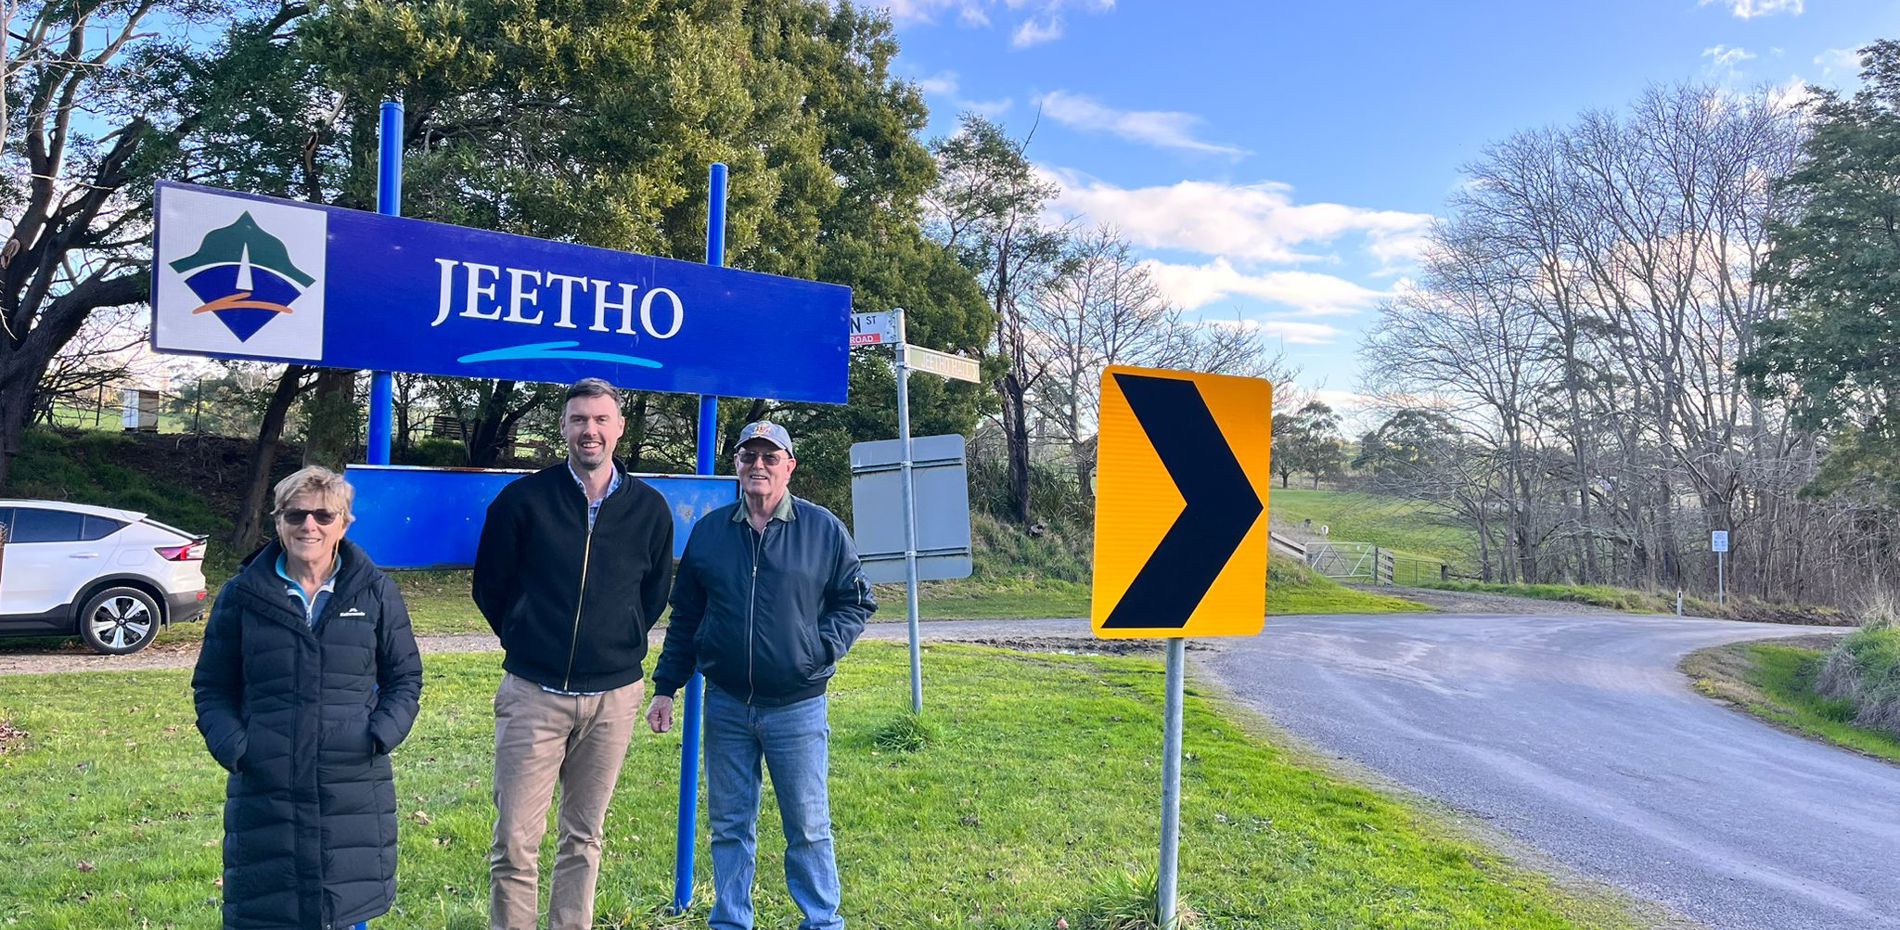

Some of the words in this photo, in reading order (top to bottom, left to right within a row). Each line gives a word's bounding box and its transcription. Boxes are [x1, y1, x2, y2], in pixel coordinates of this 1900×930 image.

[431, 258, 684, 339] JEETHO
[866, 315, 876, 325] ST
[850, 335, 874, 344] ROAD
